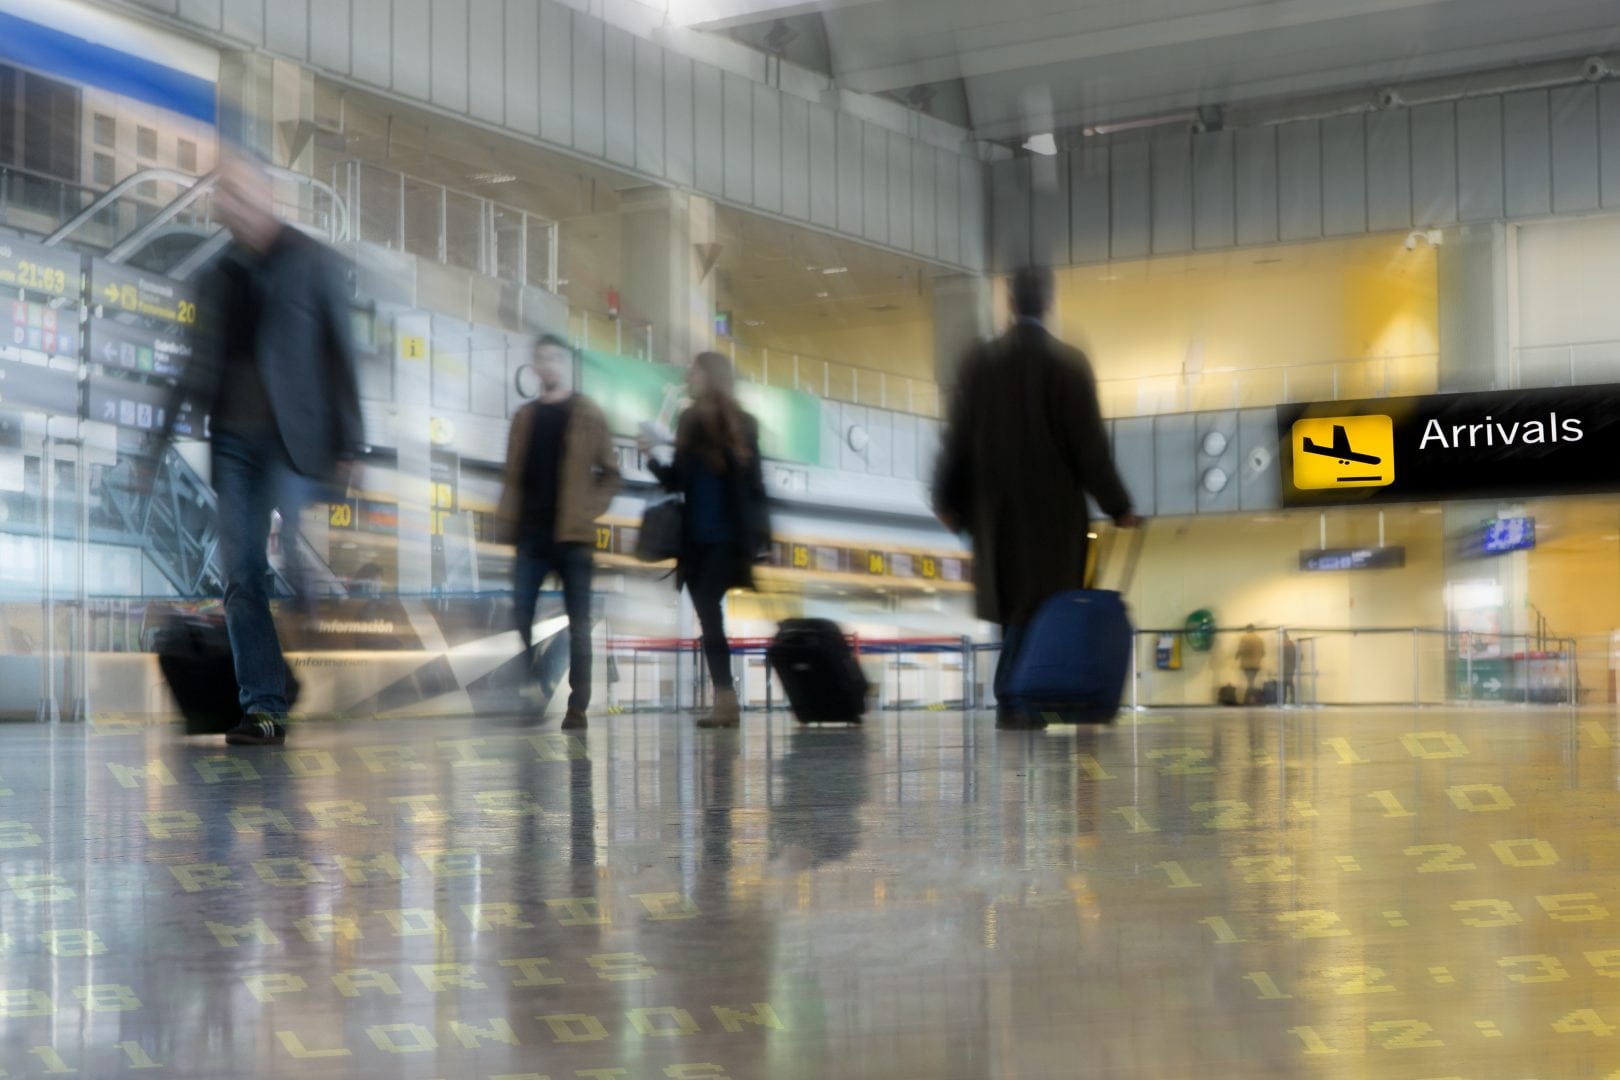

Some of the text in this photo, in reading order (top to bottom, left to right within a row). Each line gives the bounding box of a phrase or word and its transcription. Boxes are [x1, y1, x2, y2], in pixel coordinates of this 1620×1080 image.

[177, 299, 196, 324] 20
[1418, 411, 1584, 450] Arrivals
[330, 504, 351, 527] 20
[105, 732, 589, 789] MADRID
[139, 789, 545, 840] PARIS
[168, 849, 495, 893] ROME
[1154, 838, 1561, 888] 12:20
[204, 891, 703, 947] MADRID
[1198, 892, 1611, 944] 12:35
[240, 952, 658, 1002] PARIS
[275, 1002, 785, 1058] LONDON
